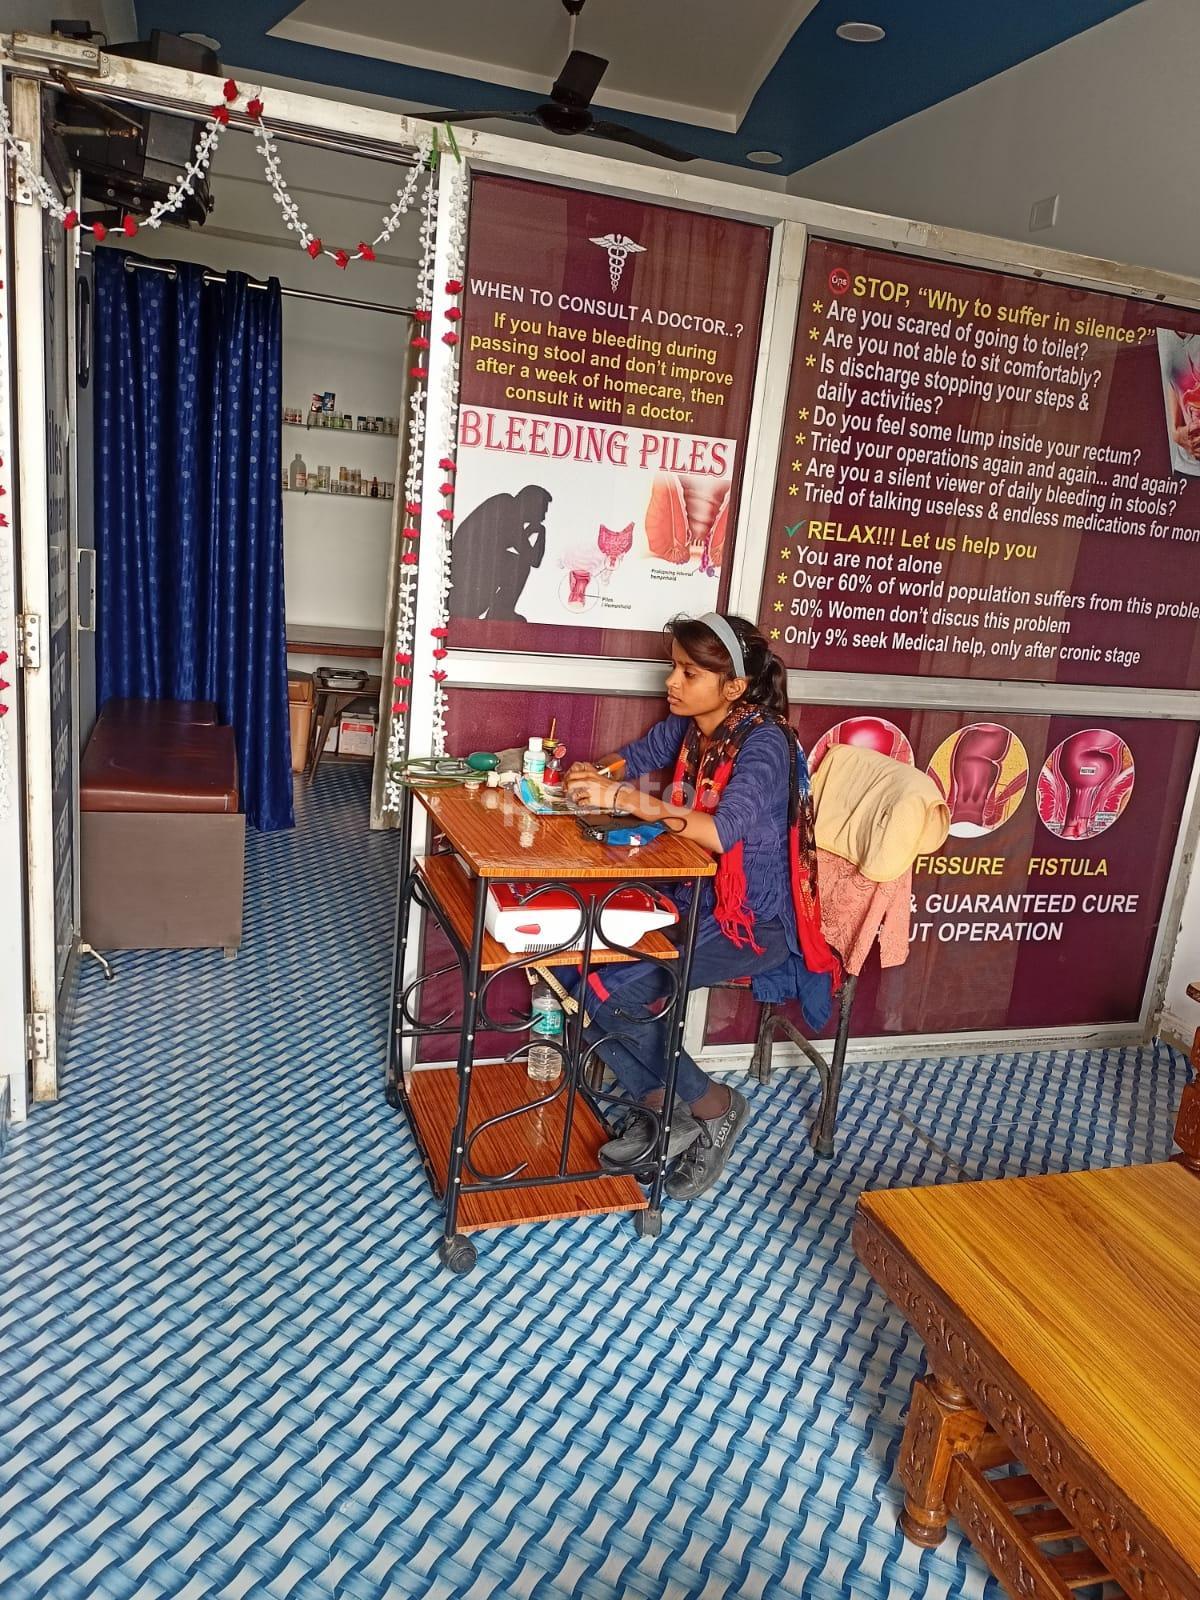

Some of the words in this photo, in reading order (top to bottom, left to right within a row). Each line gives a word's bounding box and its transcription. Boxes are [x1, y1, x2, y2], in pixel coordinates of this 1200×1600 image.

[470, 278, 524, 302] WHEN
[530, 289, 553, 306] TO
[558, 294, 638, 320] CONSULT
[641, 308, 653, 324] A
[853, 276, 910, 308] STOP,
[974, 298, 992, 318] to
[997, 306, 1050, 328] suffer
[1054, 312, 1070, 332] in
[494, 312, 506, 328] If
[510, 318, 541, 334] you
[548, 321, 586, 341] have
[592, 328, 661, 356] bleeding
[666, 341, 717, 365] during
[826, 300, 856, 323] Are
[860, 310, 892, 330] you
[897, 316, 951, 338] scared
[955, 323, 973, 342] of
[974, 328, 1018, 354] going
[1023, 334, 1038, 353] to
[1042, 337, 1088, 360] toilet?
[471, 336, 538, 360] passing
[544, 346, 585, 364] stool
[590, 354, 620, 369] and
[671, 362, 733, 385] improve
[476, 357, 515, 375] after
[520, 366, 529, 378] a
[535, 368, 578, 385] week
[583, 373, 600, 388] of
[604, 374, 685, 403] homecare,
[691, 388, 724, 405] then
[820, 352, 834, 374] Is
[840, 357, 920, 390] discharge
[924, 371, 993, 401] stopping
[996, 384, 1032, 403] your
[1034, 388, 1074, 411] steps
[1078, 392, 1089, 411] &
[822, 327, 853, 350] Are
[857, 336, 888, 356] you
[893, 342, 920, 360] not
[924, 344, 956, 366] able
[962, 349, 976, 368] to
[980, 353, 1000, 372] sit
[1004, 360, 1101, 391] comfortably?
[506, 387, 568, 406] consult
[573, 392, 584, 408] it
[588, 396, 621, 413] with
[624, 403, 635, 415] a
[641, 402, 693, 422] doctor.
[817, 380, 857, 408] daily
[861, 389, 943, 414] activities?
[459, 410, 628, 467] BLEEDING
[639, 434, 729, 478] PILES
[814, 406, 836, 426] Do
[840, 414, 871, 433] you
[876, 414, 906, 435] feel
[909, 423, 952, 441] some
[956, 424, 994, 450] lump
[998, 430, 1043, 453] inside
[1045, 441, 1080, 459] your
[1083, 446, 1141, 466] rectum?
[805, 457, 835, 478] Are
[838, 466, 870, 484] you
[874, 470, 883, 483] a
[888, 467, 931, 489] silent
[936, 473, 986, 494] viewer
[989, 479, 1006, 496] of
[1008, 481, 1043, 505] daily
[1046, 485, 1106, 513] bleeding
[1110, 492, 1122, 510] in
[1126, 497, 1176, 516] stools?
[811, 431, 852, 455] Tried
[854, 442, 893, 461] your
[897, 447, 979, 469] operations
[983, 456, 1023, 476] again
[1027, 461, 1055, 478] and
[1112, 472, 1139, 489] and
[1141, 477, 1187, 496] again?
[804, 482, 844, 504] Tried
[848, 488, 867, 506] of
[869, 490, 922, 516] talking
[926, 498, 983, 518] useless
[988, 502, 998, 520] &
[1003, 506, 1059, 526] endless
[1063, 513, 1146, 536] medications
[1150, 520, 1170, 538] for
[797, 545, 828, 565] You
[834, 553, 860, 568] are
[866, 554, 894, 570] not
[897, 554, 942, 574] alone
[808, 521, 895, 546] RELAX!!!
[901, 529, 930, 549] Let
[935, 537, 956, 551] us
[962, 535, 1000, 559] help
[1004, 544, 1037, 560] you
[790, 598, 822, 618] 50%
[829, 600, 885, 621] Women
[932, 608, 979, 627] discus
[984, 612, 1010, 629] this
[1013, 615, 1070, 634] problem
[793, 570, 834, 590] Over
[838, 573, 872, 593] 60%
[878, 577, 896, 594] of
[899, 580, 944, 598] world
[947, 585, 1030, 604] population
[1034, 590, 1086, 608] suffers
[1090, 593, 1122, 612] from
[1127, 597, 1152, 614] this
[1155, 601, 1200, 619] proble
[785, 626, 821, 649] Only
[825, 628, 848, 646] 9%
[852, 632, 888, 648] seek
[892, 632, 949, 652] Medical
[952, 636, 986, 658] help,
[991, 640, 1022, 660] only
[1025, 641, 1057, 658] after
[1060, 645, 1102, 661] cronic
[1104, 647, 1140, 667] stage
[914, 855, 1005, 875] FISSURE
[1028, 858, 1107, 876] FISTULA
[926, 894, 1076, 913] GUARANTEED
[1082, 894, 1139, 913] CURE
[938, 922, 1063, 942] OPERATION
